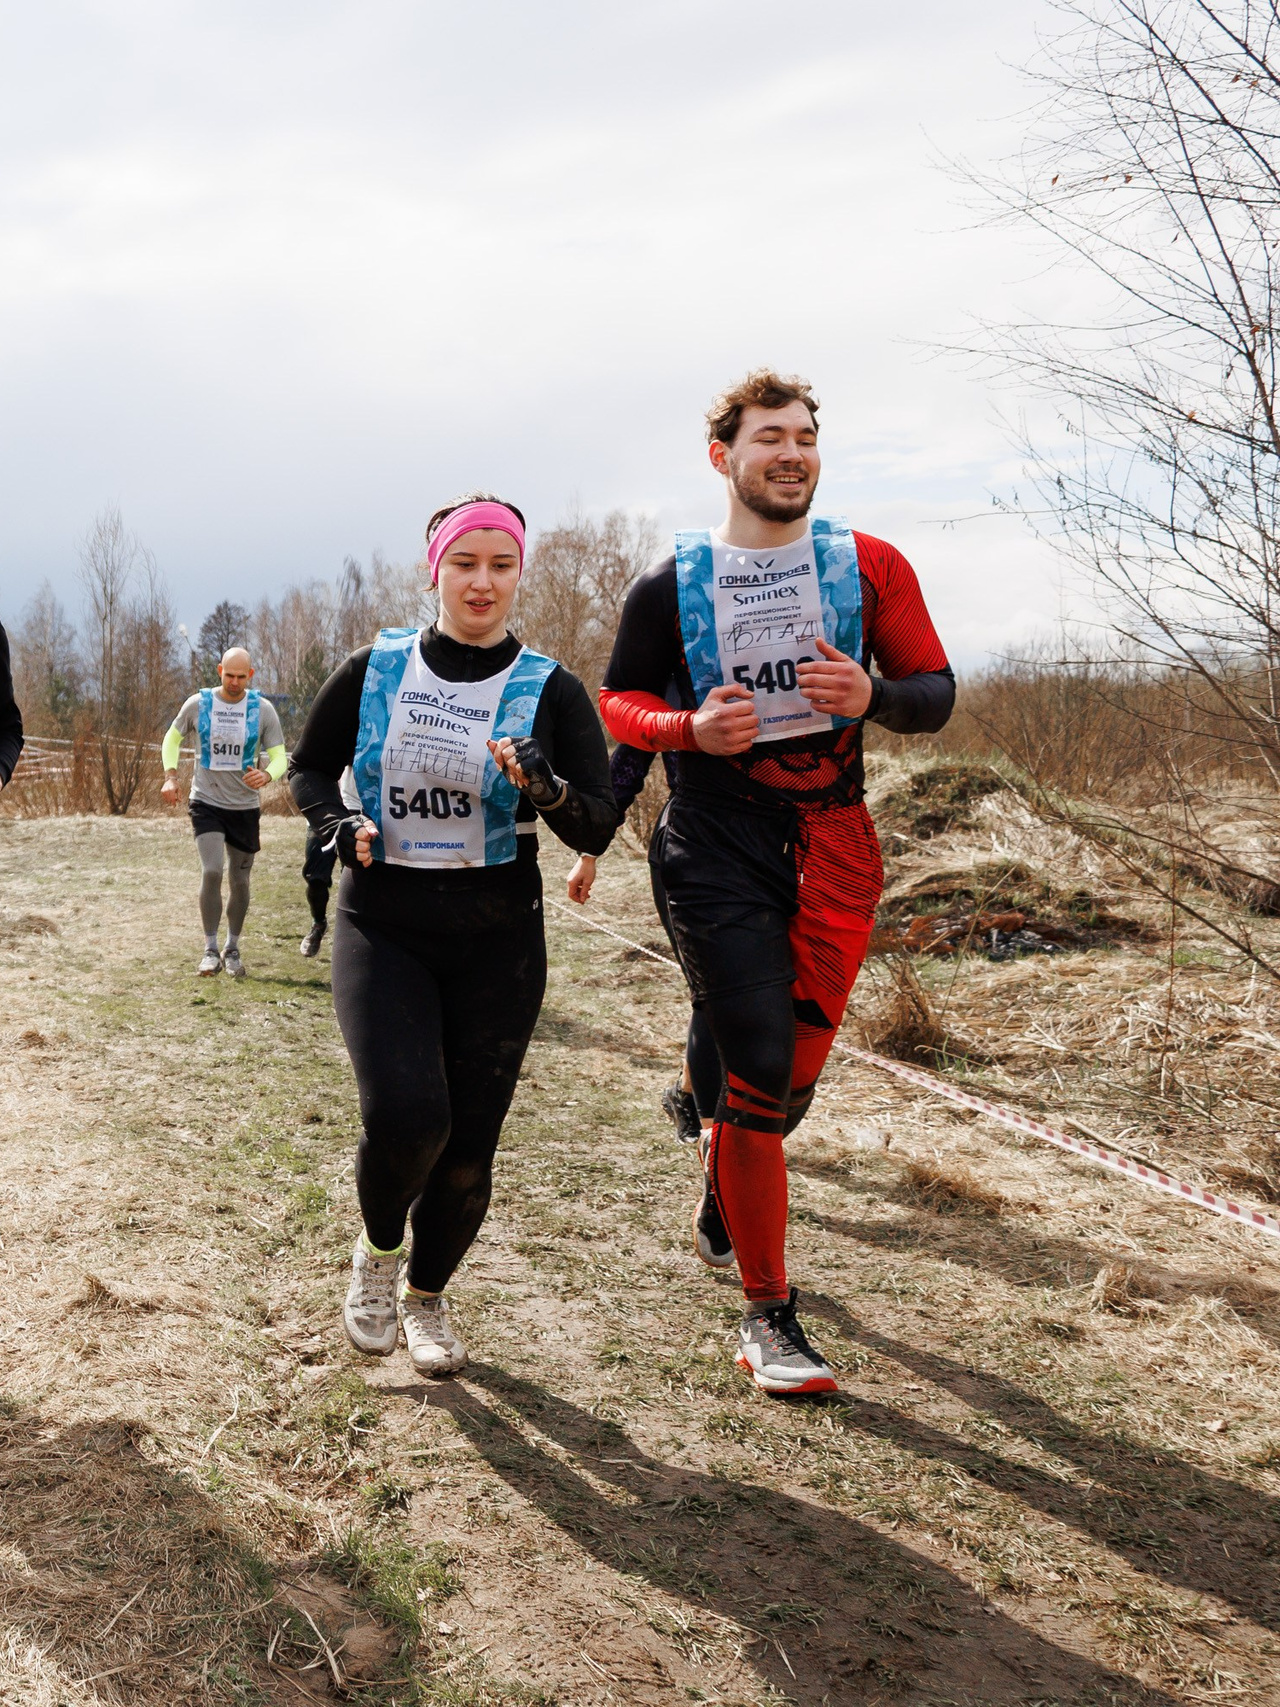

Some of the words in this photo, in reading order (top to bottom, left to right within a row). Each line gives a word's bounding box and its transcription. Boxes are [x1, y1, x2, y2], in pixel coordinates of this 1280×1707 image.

[719, 574, 760, 585] ГОНКА
[764, 563, 810, 583] ГЕРОЕВ
[733, 585, 799, 608] Sminex
[734, 605, 801, 618] ПЕРФЕКЦИОНИСТЫ
[753, 613, 802, 624] DEVELOPMENT
[732, 656, 816, 694] 540
[401, 691, 439, 705] ГОНКА
[443, 702, 490, 718] ГЕРОЕВ
[407, 709, 471, 736] Sminex
[763, 711, 813, 725] ГАЗПРОМБАНК
[403, 732, 469, 748] ПЕРФЕКЦИОНИСТЫ
[213, 743, 241, 756] 5410
[418, 742, 467, 756] DEVELOPMENT
[389, 786, 472, 819] 5403
[414, 841, 465, 849] ГАЗПРОМБАНК
